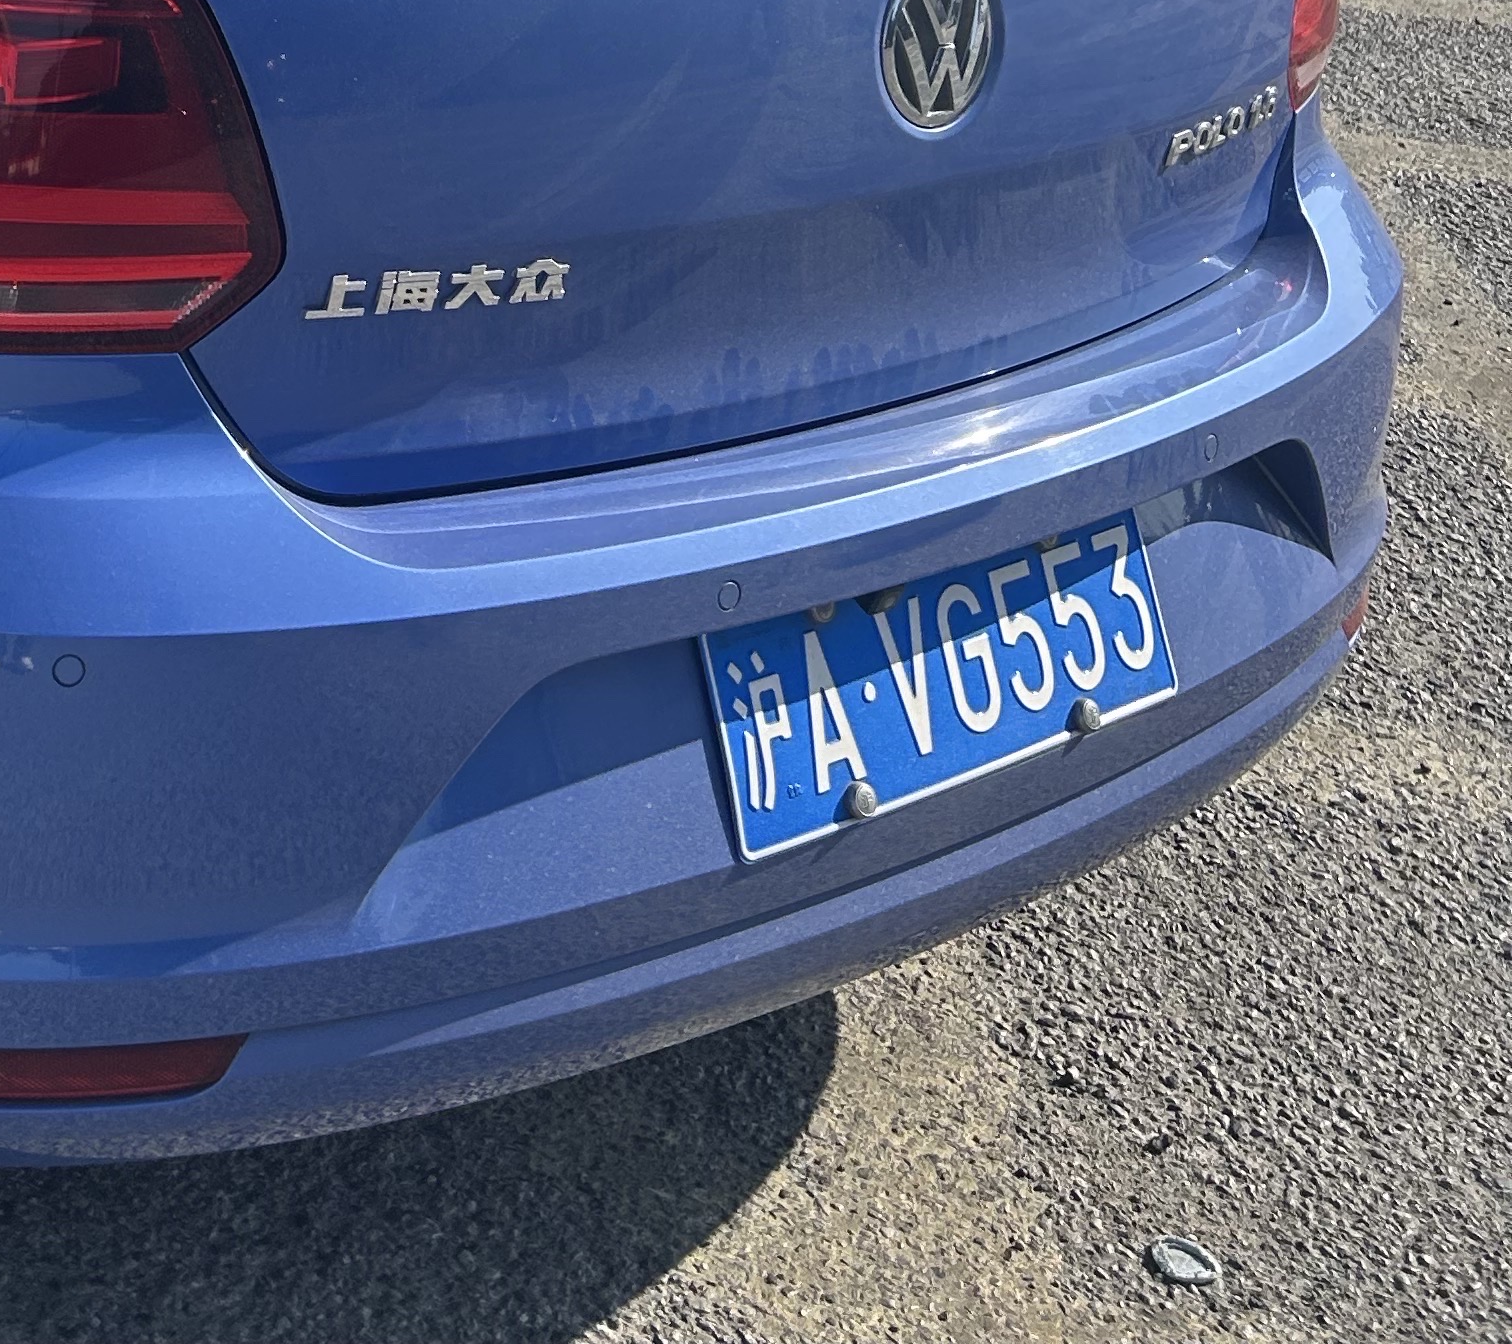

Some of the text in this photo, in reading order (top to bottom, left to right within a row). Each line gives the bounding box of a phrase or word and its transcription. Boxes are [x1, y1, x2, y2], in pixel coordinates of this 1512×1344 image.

[1165, 106, 1246, 166] POLO
[304, 258, 571, 320] 上海大众
